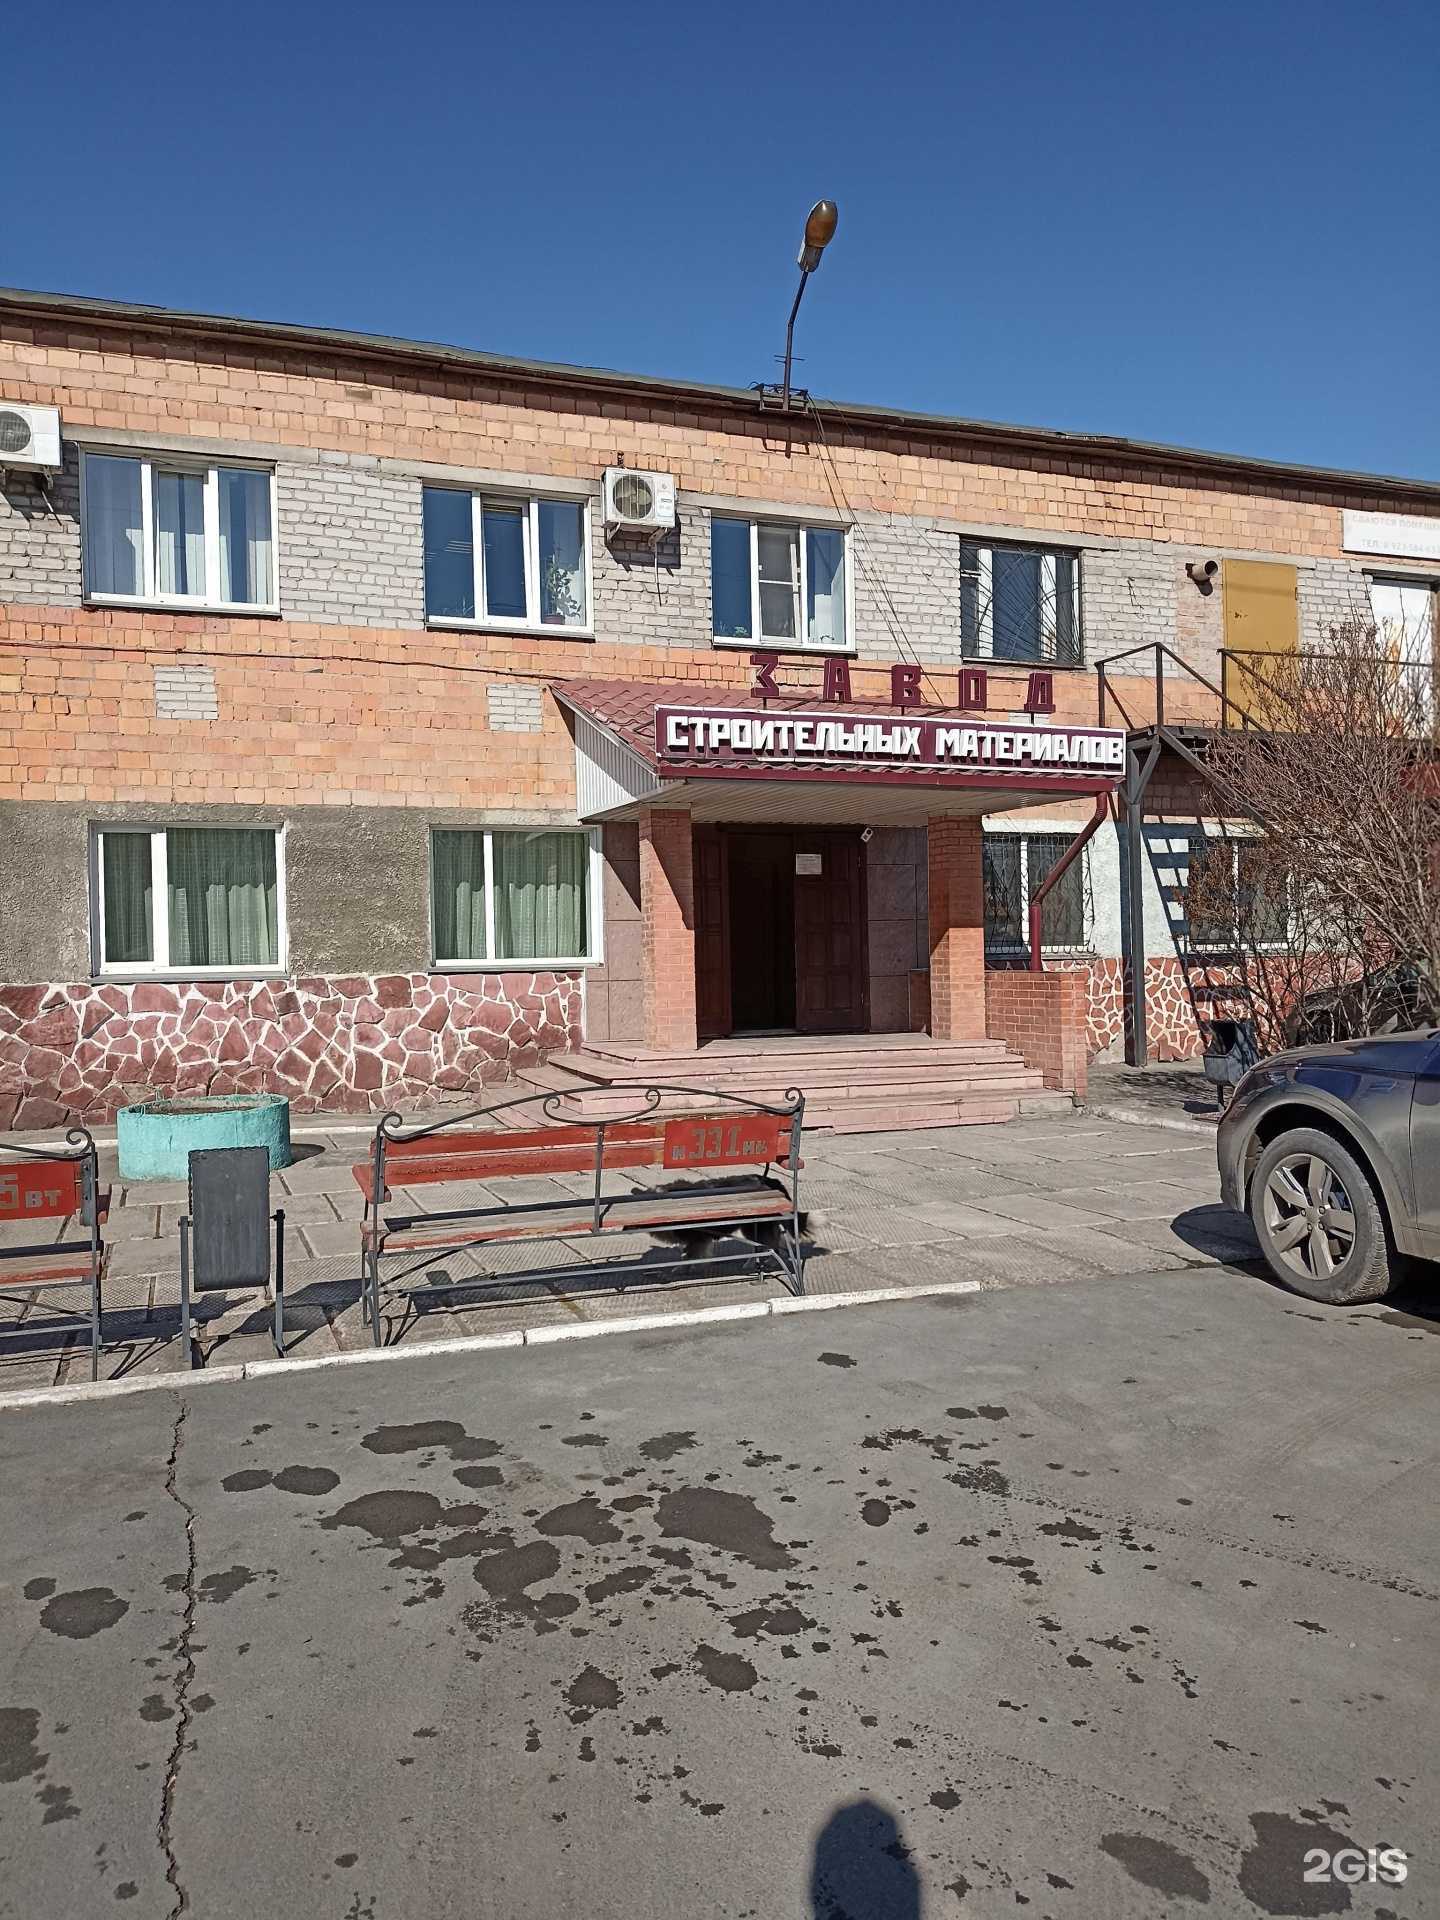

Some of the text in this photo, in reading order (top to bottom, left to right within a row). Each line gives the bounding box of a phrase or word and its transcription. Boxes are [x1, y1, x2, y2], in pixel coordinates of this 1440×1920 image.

[750, 654, 1056, 713] ЗАВОД
[667, 715, 1123, 766] СТРОИТЕЛЬНЫХ МАТЕРИАЛОВ
